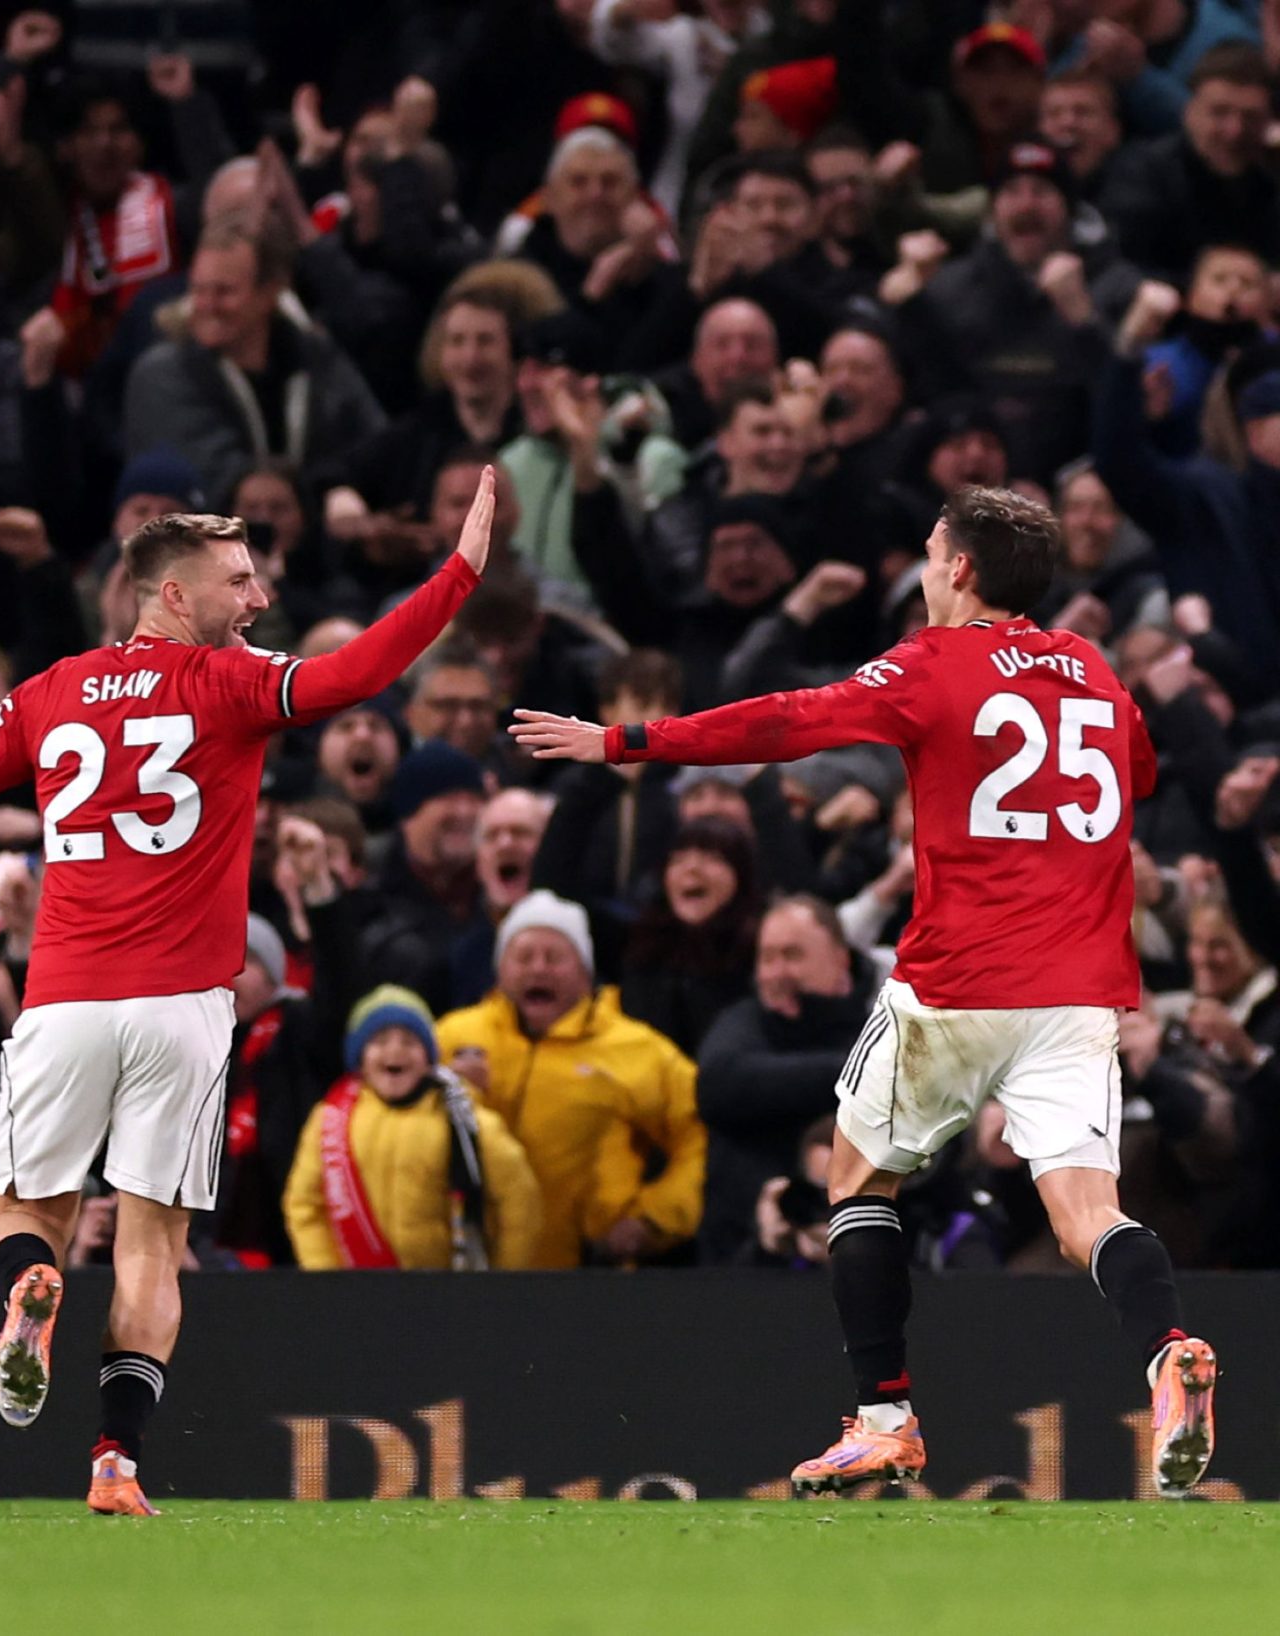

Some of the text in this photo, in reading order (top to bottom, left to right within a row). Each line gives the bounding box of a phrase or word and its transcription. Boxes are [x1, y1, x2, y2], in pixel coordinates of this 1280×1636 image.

[81, 669, 163, 705] SHAW
[988, 645, 1088, 686] UGTE
[38, 714, 202, 863] 23
[969, 692, 1121, 843] 25
